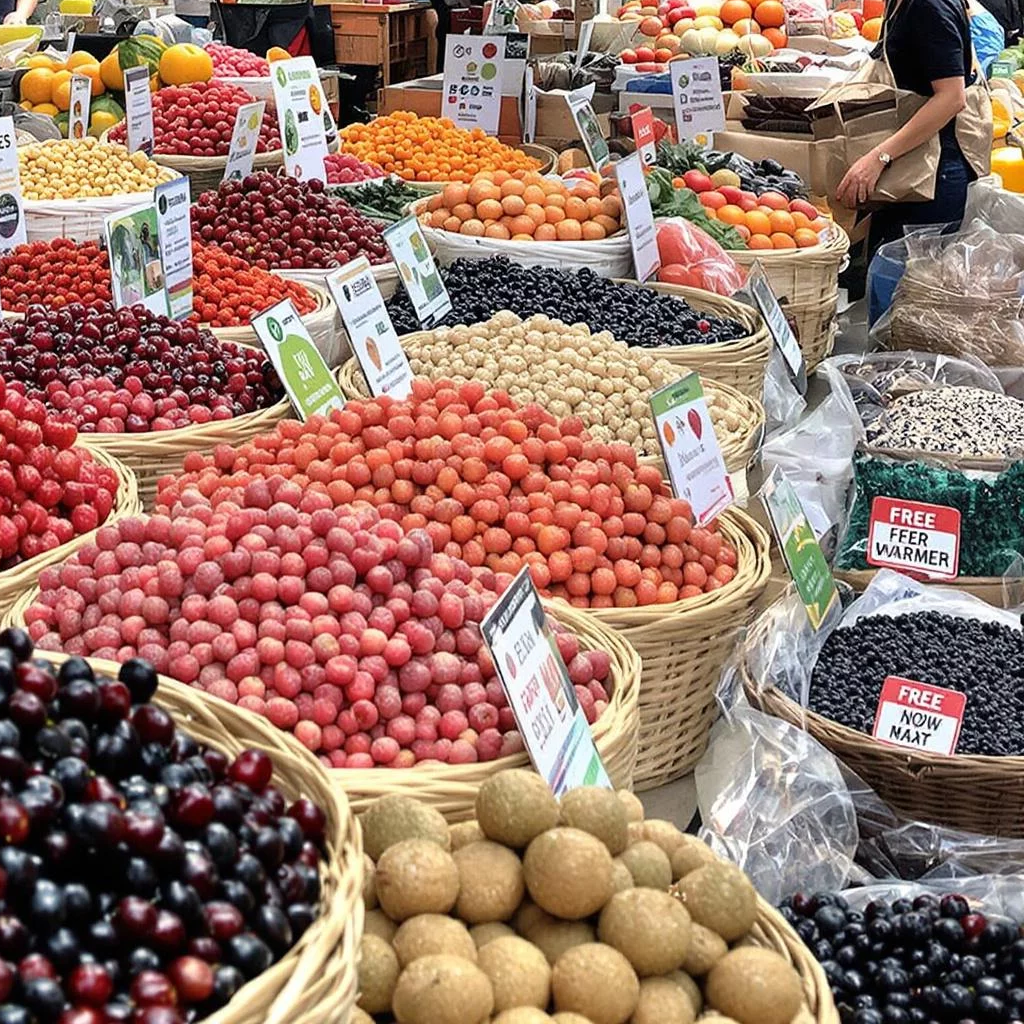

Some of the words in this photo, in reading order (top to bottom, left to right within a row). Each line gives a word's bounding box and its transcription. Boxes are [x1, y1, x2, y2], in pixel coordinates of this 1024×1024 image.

[889, 506, 936, 529] FREE
[889, 527, 929, 547] FFER
[875, 541, 950, 568] WARMER
[897, 685, 945, 711] FREE
[899, 709, 943, 732] NOW
